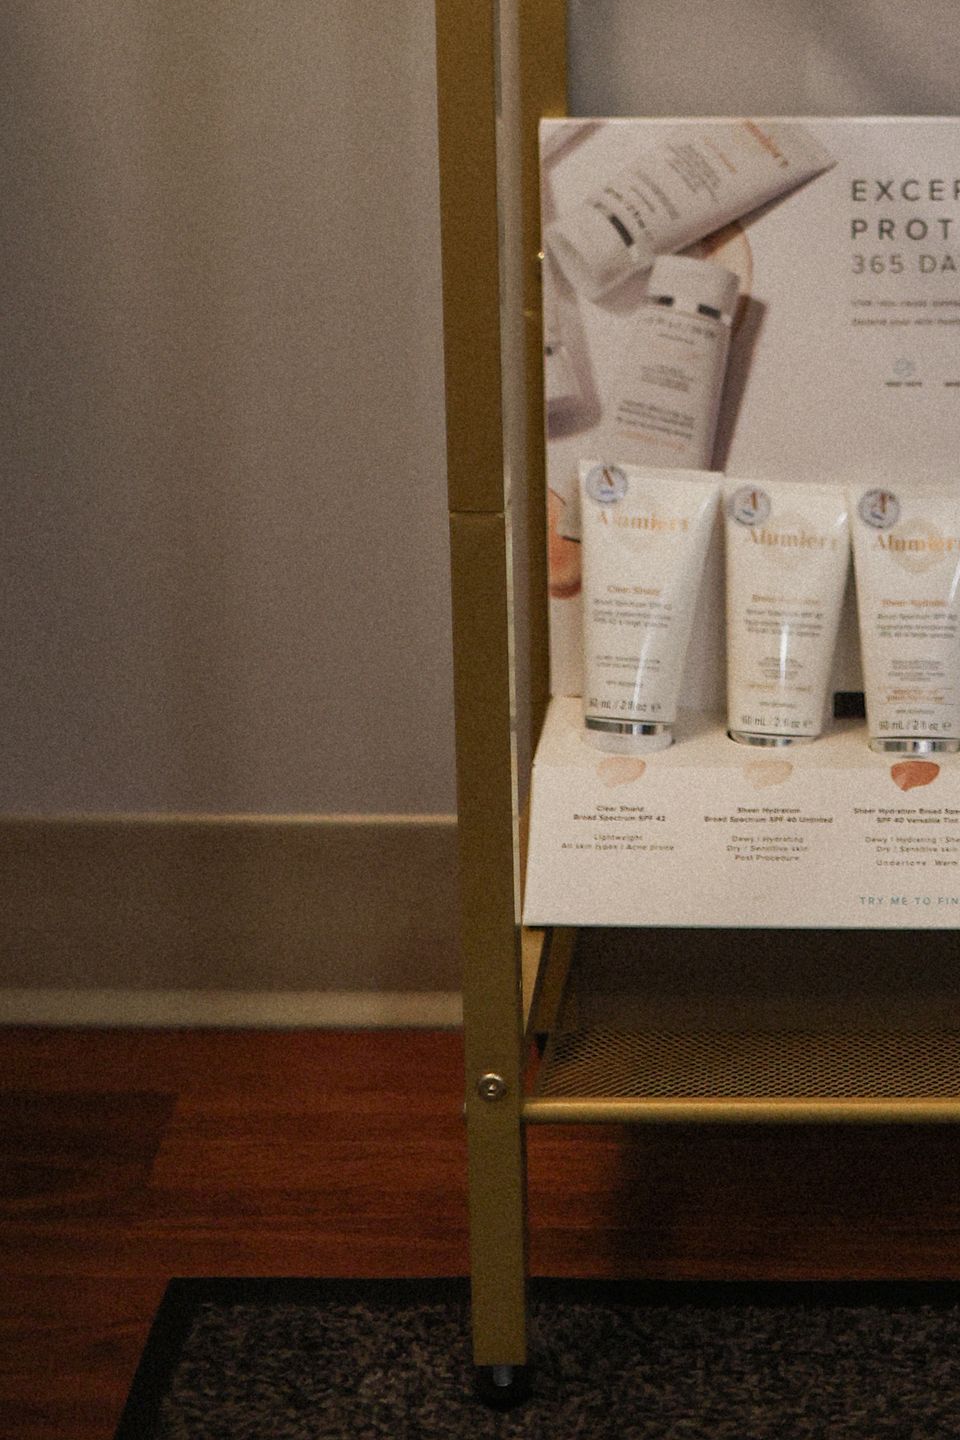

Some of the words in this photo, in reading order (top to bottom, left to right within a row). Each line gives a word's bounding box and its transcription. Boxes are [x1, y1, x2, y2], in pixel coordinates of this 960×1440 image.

[852, 253, 904, 274] 365
[859, 897, 883, 905] TRY
[890, 897, 907, 905] ME
[914, 897, 931, 905] TO
